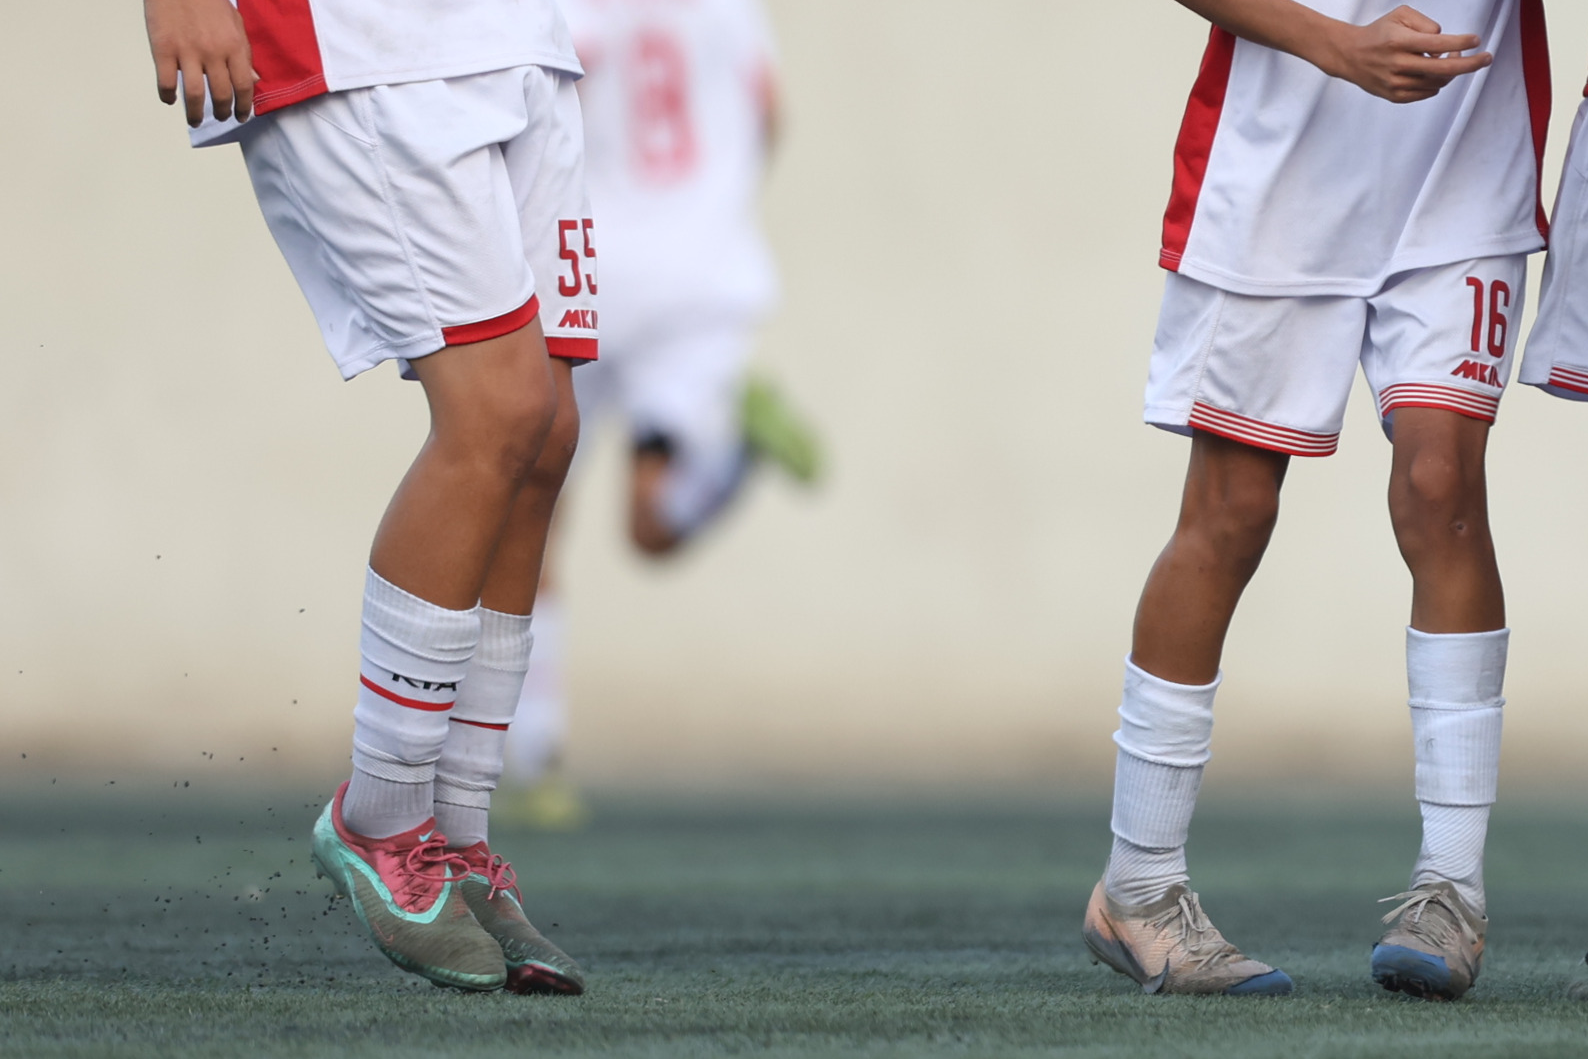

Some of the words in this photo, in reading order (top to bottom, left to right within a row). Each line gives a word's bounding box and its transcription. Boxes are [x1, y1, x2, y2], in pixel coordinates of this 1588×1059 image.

[558, 218, 598, 298] 55
[557, 309, 598, 330] MKI
[1465, 276, 1511, 359] 16
